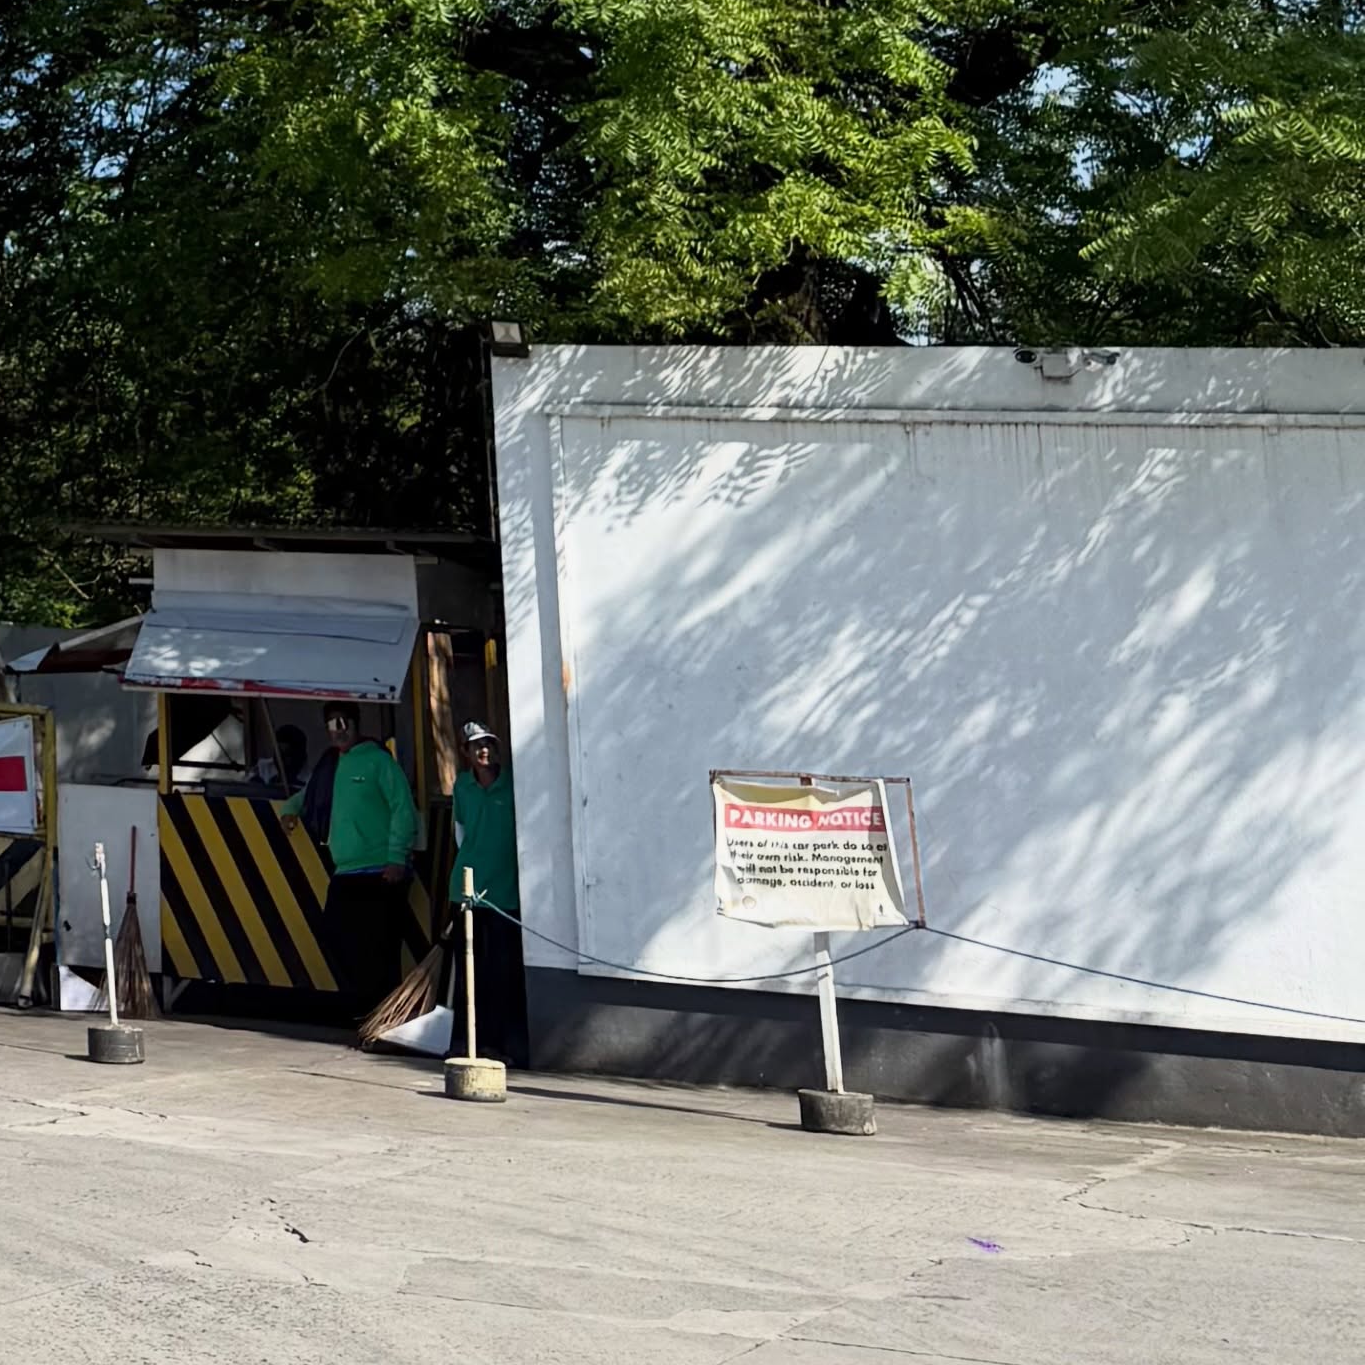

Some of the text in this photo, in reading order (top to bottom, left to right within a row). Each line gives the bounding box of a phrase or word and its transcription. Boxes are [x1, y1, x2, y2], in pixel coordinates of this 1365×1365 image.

[729, 809, 882, 829] PARKING NOTICE
[813, 840, 840, 852] park
[843, 840, 858, 850] do
[811, 853, 884, 865] Management
[797, 866, 860, 877] responsible
